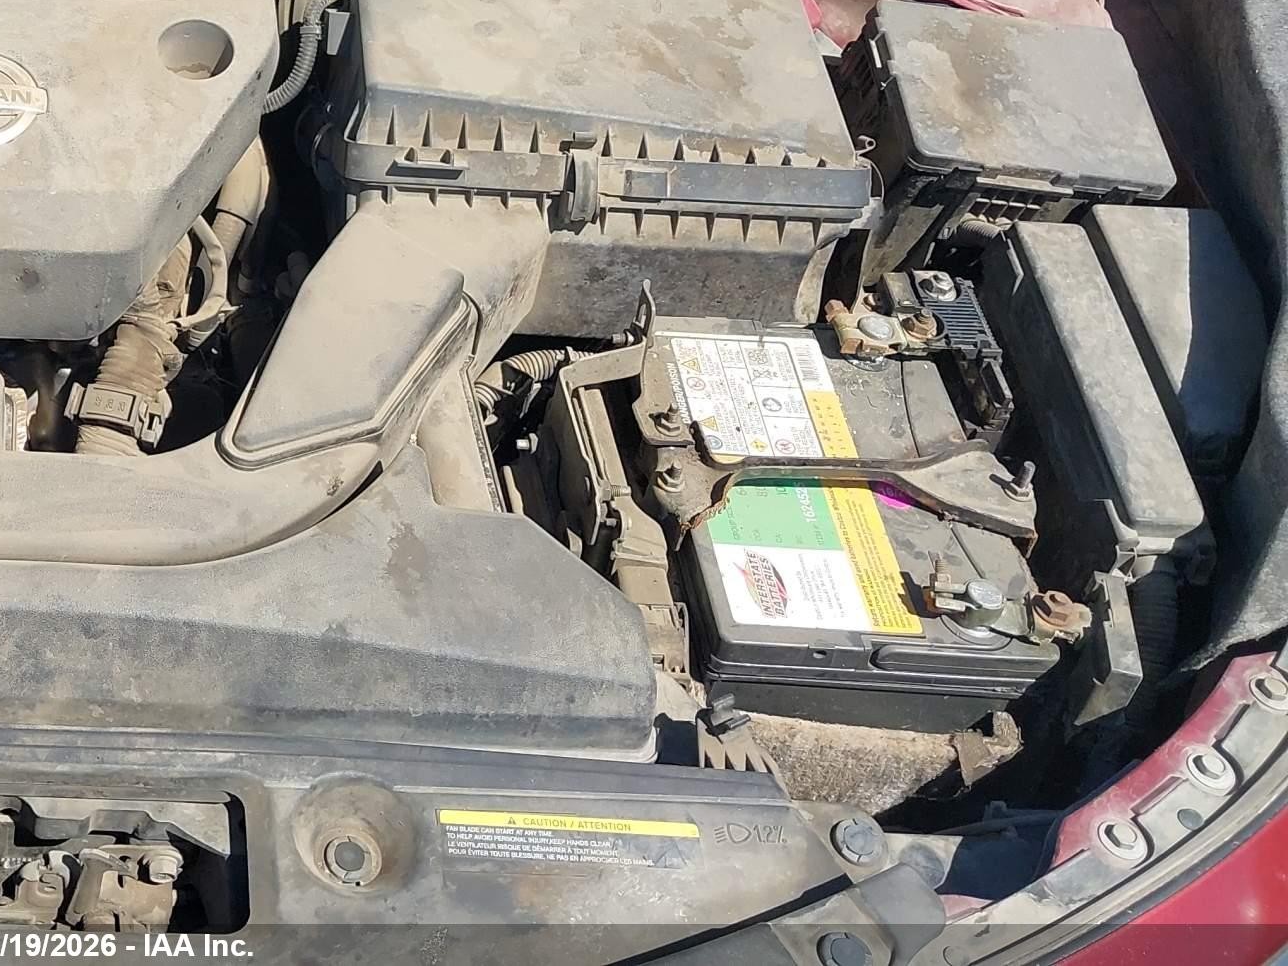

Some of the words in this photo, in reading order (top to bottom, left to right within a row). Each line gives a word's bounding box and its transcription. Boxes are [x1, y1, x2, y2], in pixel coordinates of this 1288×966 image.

[747, 552, 773, 616] INTERSTATE
[760, 558, 785, 616] BATTERIES
[523, 818, 566, 827] CAUTION
[578, 821, 631, 831] ATTENTION
[494, 835, 527, 843] PERSONAL
[467, 848, 489, 856] ÉVITER
